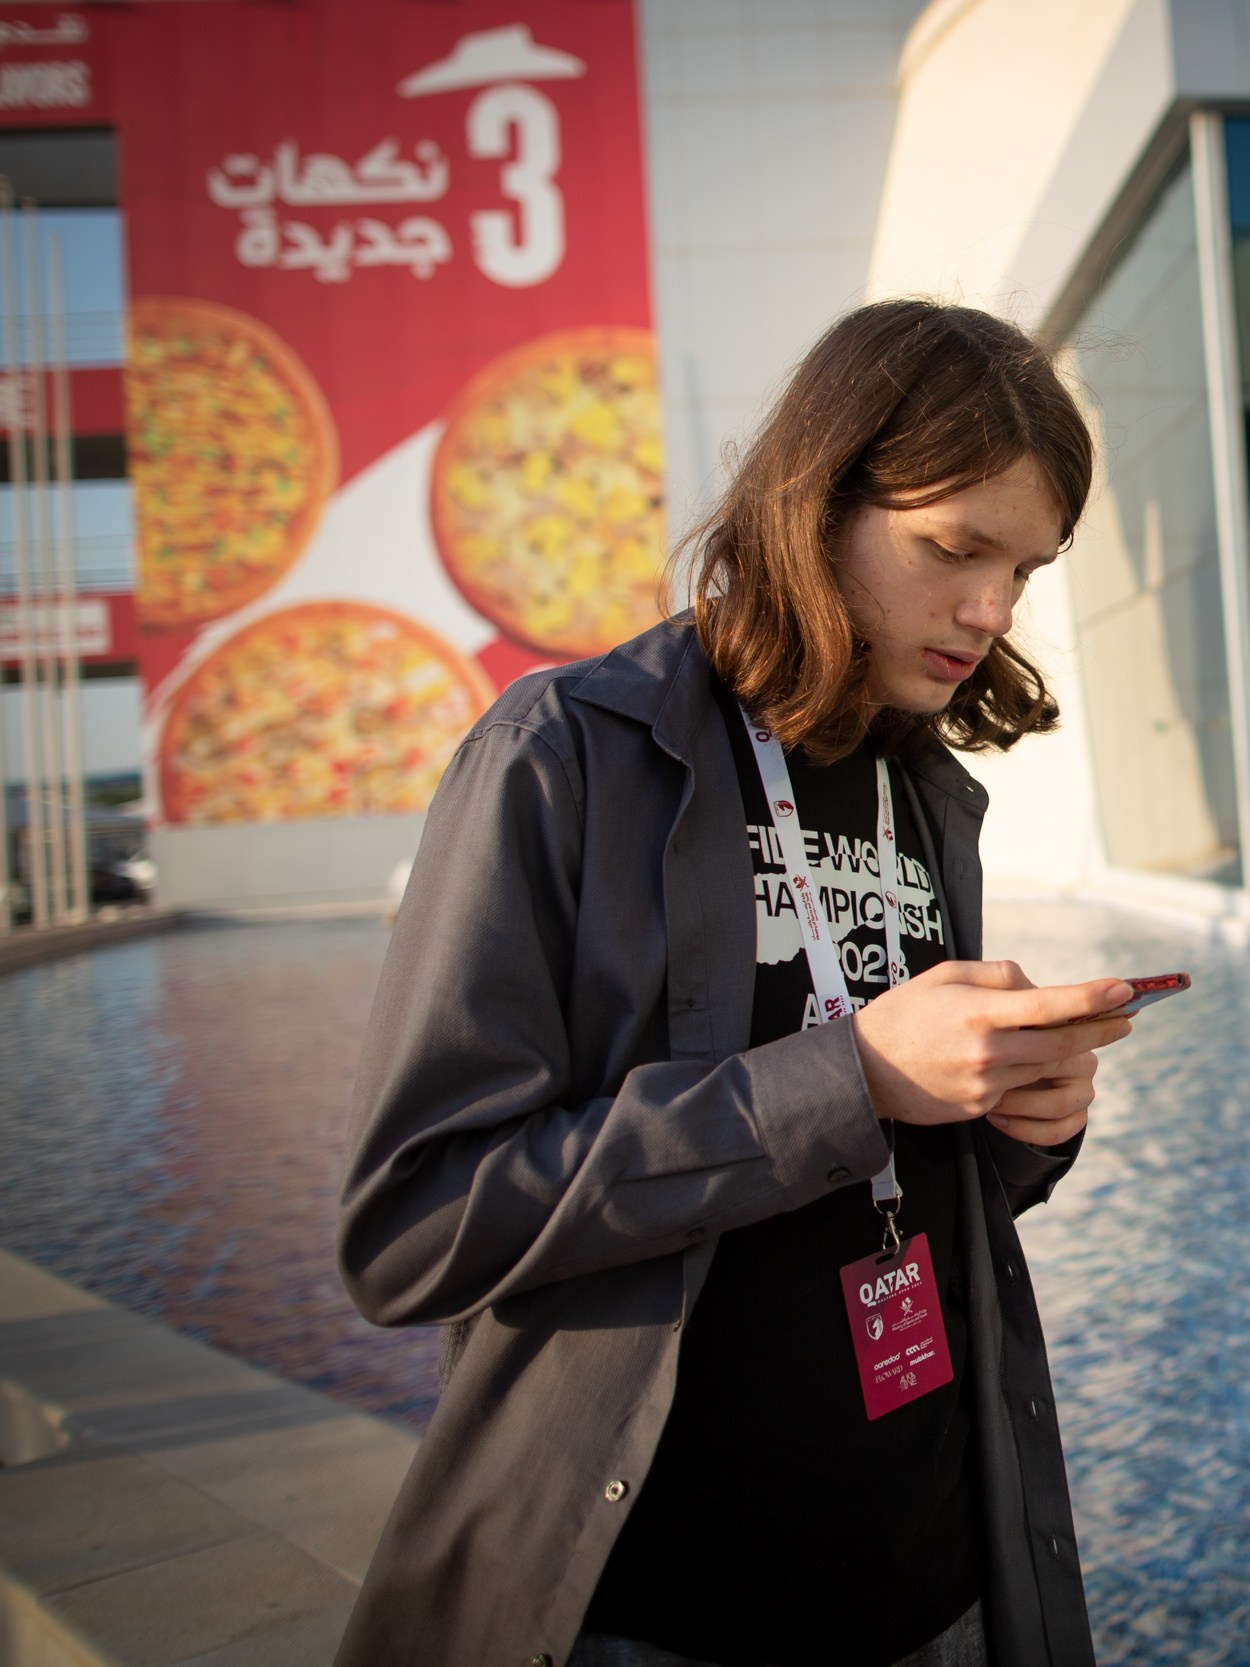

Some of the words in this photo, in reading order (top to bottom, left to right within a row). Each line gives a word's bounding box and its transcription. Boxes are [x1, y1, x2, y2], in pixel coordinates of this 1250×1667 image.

[206, 136, 450, 208] نكهات
[467, 84, 564, 287] 3
[235, 206, 453, 284] جديدة
[824, 832, 931, 893] WOLD
[859, 1262, 921, 1308] QATAR
